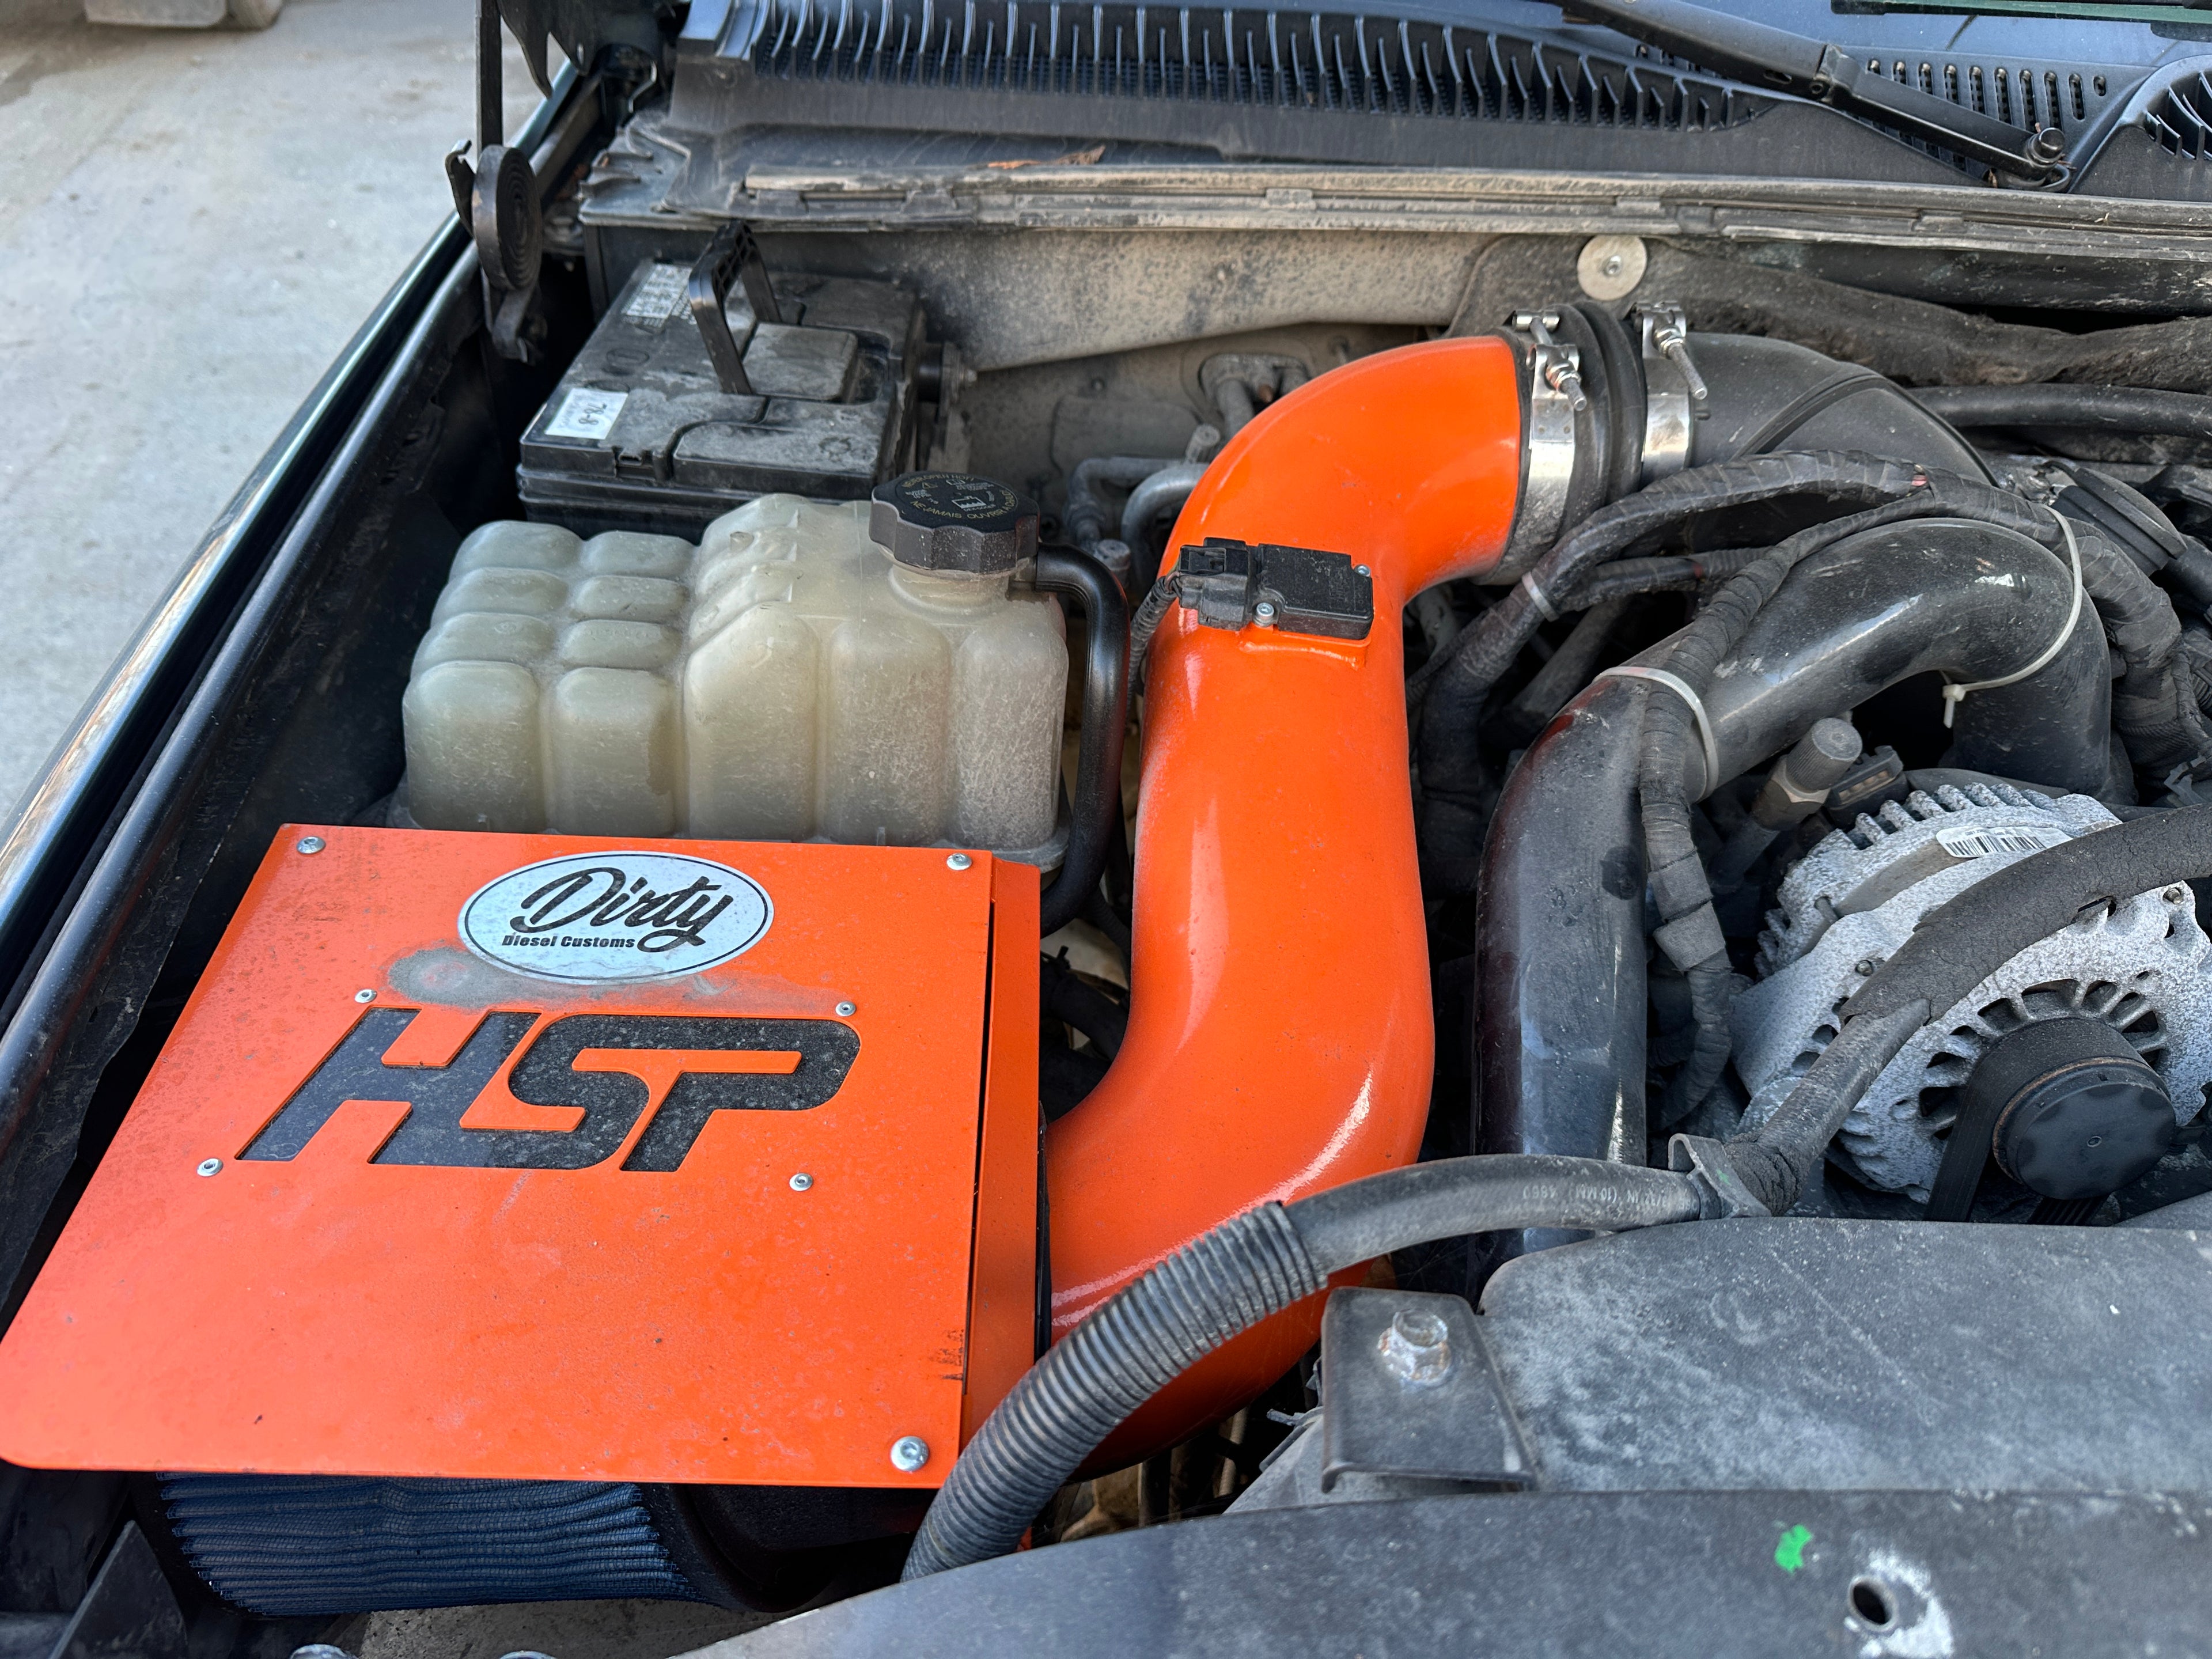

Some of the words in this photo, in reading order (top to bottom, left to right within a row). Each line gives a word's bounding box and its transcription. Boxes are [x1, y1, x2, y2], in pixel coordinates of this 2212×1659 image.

[923, 507, 962, 518] JAMAIS
[967, 509, 1007, 519] OUVRIR
[510, 867, 734, 953] Dirty
[501, 935, 557, 947] Diesel
[560, 935, 635, 948] Customs
[237, 1007, 861, 1172] HSP
